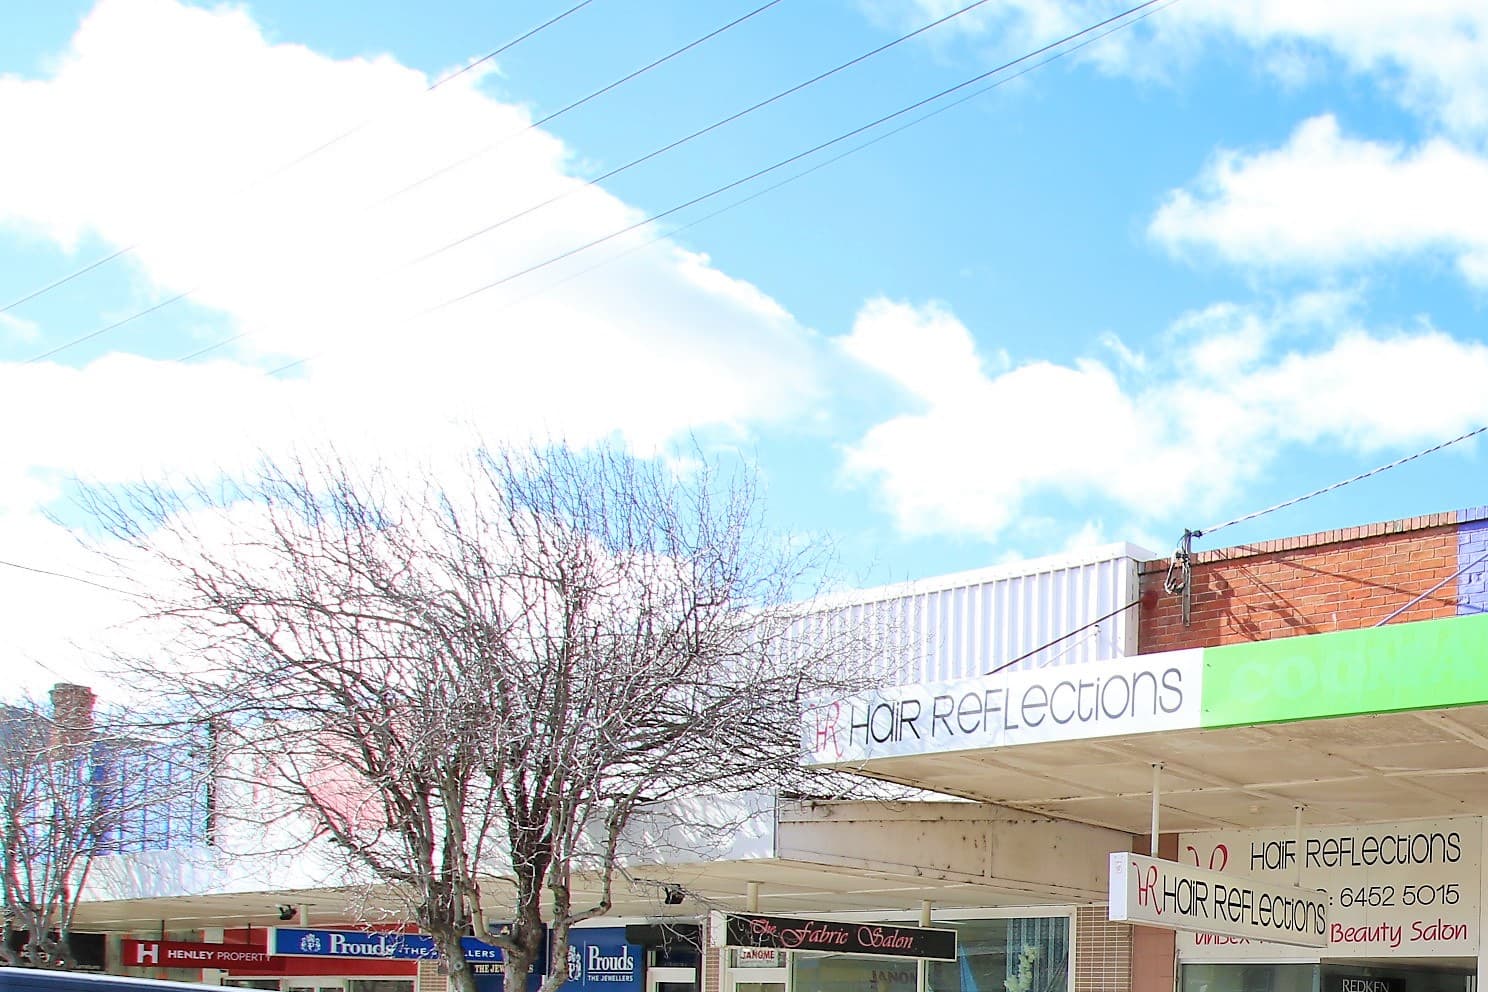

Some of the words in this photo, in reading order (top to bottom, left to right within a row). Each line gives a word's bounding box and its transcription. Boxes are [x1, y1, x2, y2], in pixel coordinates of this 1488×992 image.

[1341, 886, 1395, 907] 6452
[1402, 884, 1459, 906] 5015
[328, 933, 394, 956] Prouds
[750, 918, 777, 934] The
[781, 922, 848, 947] Fabric
[858, 926, 913, 949] Salon
[1330, 922, 1402, 948] Beauty
[1410, 919, 1468, 942] Salon
[168, 950, 213, 959] HENLEY
[217, 951, 271, 962] PROPERTY
[587, 945, 634, 971] Prouds
[740, 950, 775, 959] JANOME
[474, 965, 489, 973] THE
